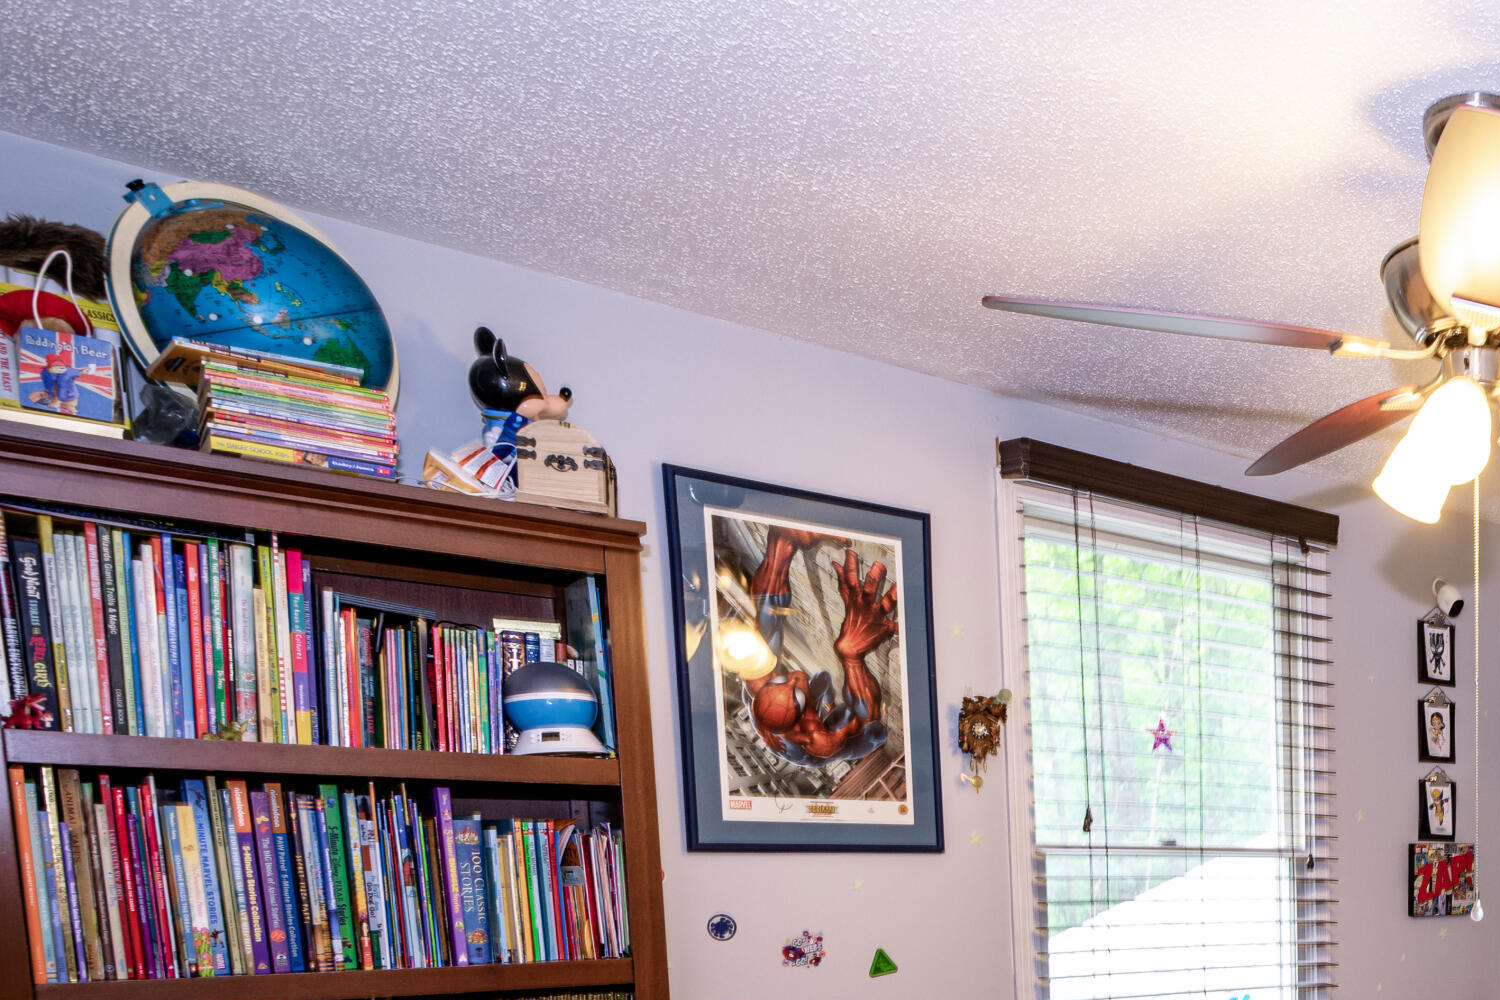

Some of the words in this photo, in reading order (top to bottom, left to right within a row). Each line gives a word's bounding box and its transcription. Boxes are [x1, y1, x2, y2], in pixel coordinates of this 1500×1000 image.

[25, 335, 79, 355] Paddington
[81, 344, 108, 359] Bear
[729, 800, 752, 810] MARVEL
[1417, 850, 1473, 904] ZAP!
